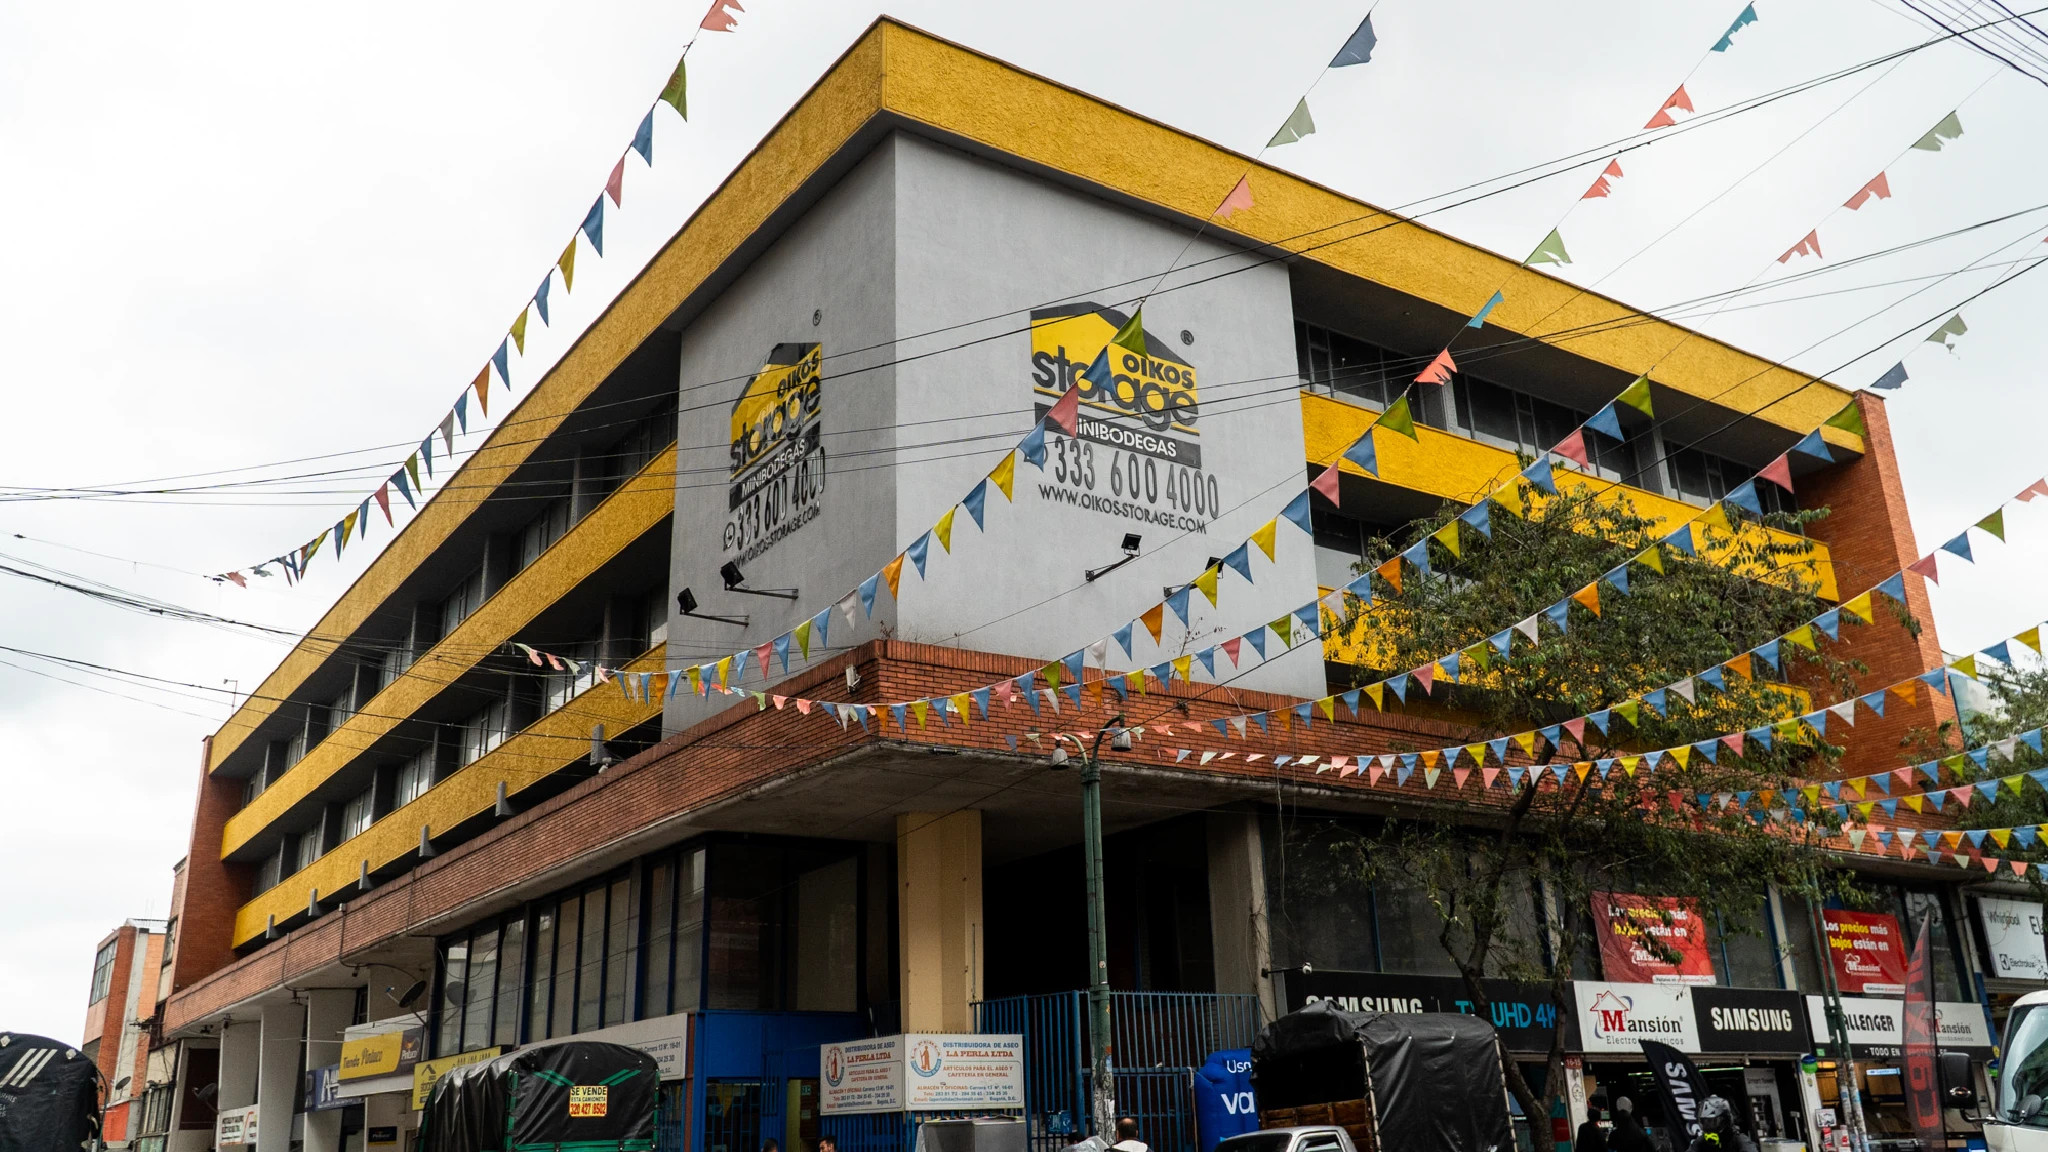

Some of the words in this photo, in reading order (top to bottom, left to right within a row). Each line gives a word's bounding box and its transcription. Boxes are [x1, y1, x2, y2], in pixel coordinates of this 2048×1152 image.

[777, 351, 819, 399] OIKOS
[1122, 354, 1194, 389] OIKOS
[1032, 347, 1199, 431] stoage
[730, 375, 821, 474] storage
[1075, 417, 1176, 457] INIBODEGAS
[742, 438, 805, 498] MINIBODEGAS
[1055, 436, 1095, 490] 333
[1111, 451, 1157, 503] 600
[1167, 464, 1219, 519] 4000
[737, 495, 760, 551] 333
[765, 475, 787, 531] 600
[792, 446, 825, 510] 4000
[1039, 484, 1207, 535] WWW.OIKOS-STORAGE.COM
[1674, 927, 1688, 937] en
[1823, 920, 1838, 931] Los
[1840, 921, 1868, 935] precios
[1870, 924, 1888, 935] más
[1829, 936, 1852, 950] bajos
[1853, 938, 1877, 950] están
[1878, 941, 1889, 951] en
[1490, 1002, 1532, 1028] UHD
[1601, 1010, 1682, 1033] Mansión
[1711, 1007, 1792, 1032] SAMSUNG
[845, 1044, 876, 1053] DISTRIBUIDORA
[884, 1041, 896, 1049] ASEO
[856, 1054, 875, 1062] PERLA
[1869, 1048, 1889, 1056] TODO
[1891, 1048, 1900, 1056] EN
[571, 1087, 580, 1096] SE
[582, 1087, 606, 1096] VENDE
[571, 1103, 580, 1115] 320
[582, 1103, 591, 1115] 427
